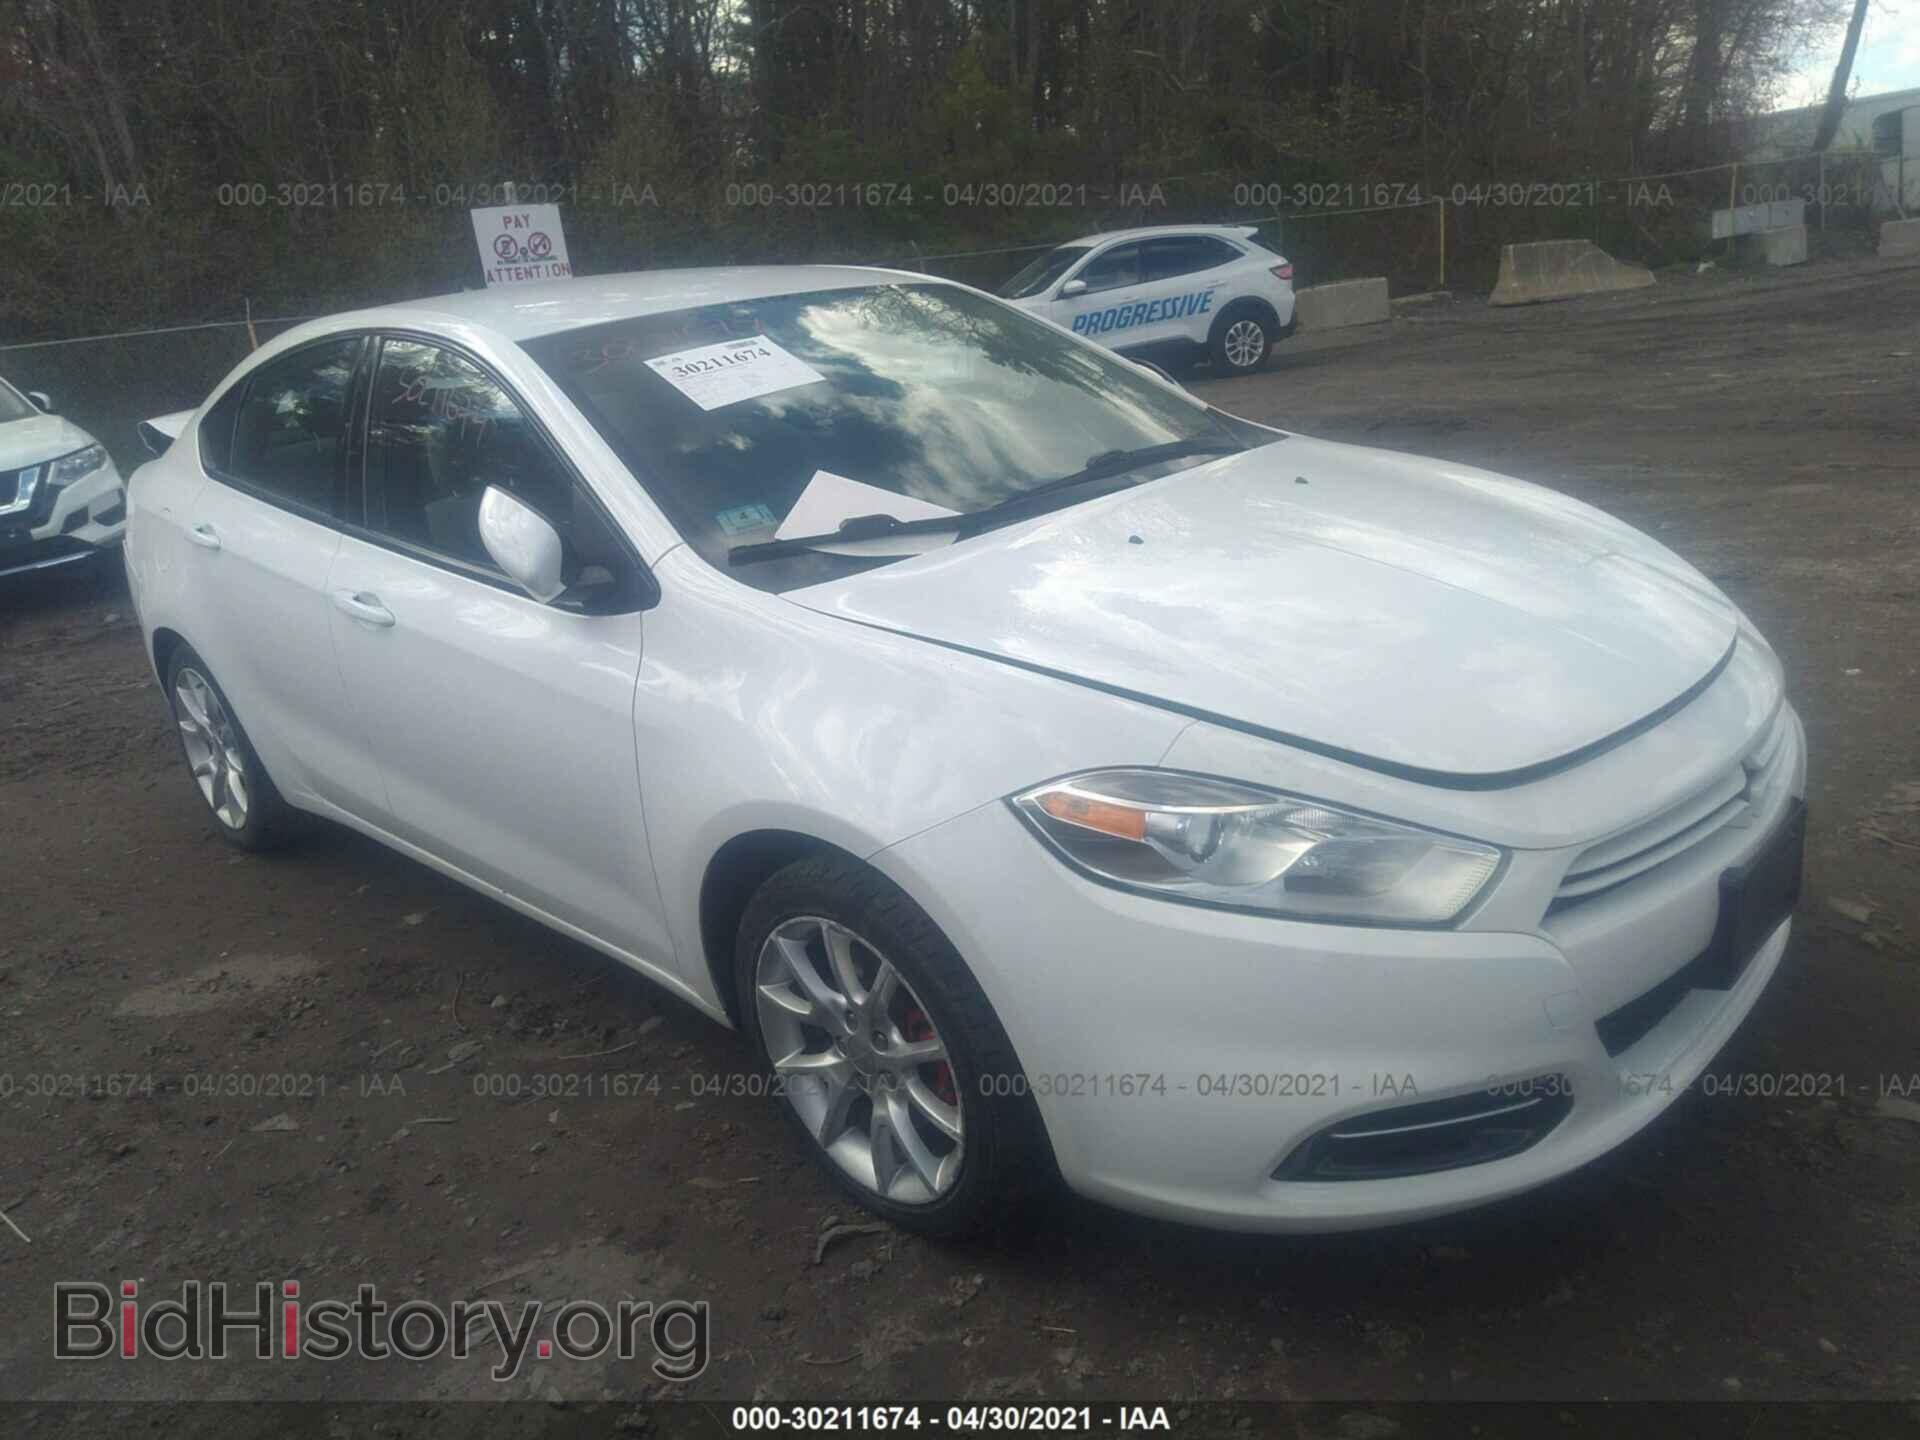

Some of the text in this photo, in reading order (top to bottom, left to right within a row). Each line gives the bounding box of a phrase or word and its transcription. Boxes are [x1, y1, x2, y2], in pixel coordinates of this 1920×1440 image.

[502, 213, 530, 230] PAY
[486, 262, 573, 283] ATTENTION
[1071, 289, 1215, 336] PROGRESSIVE
[672, 346, 772, 378] 30211674
